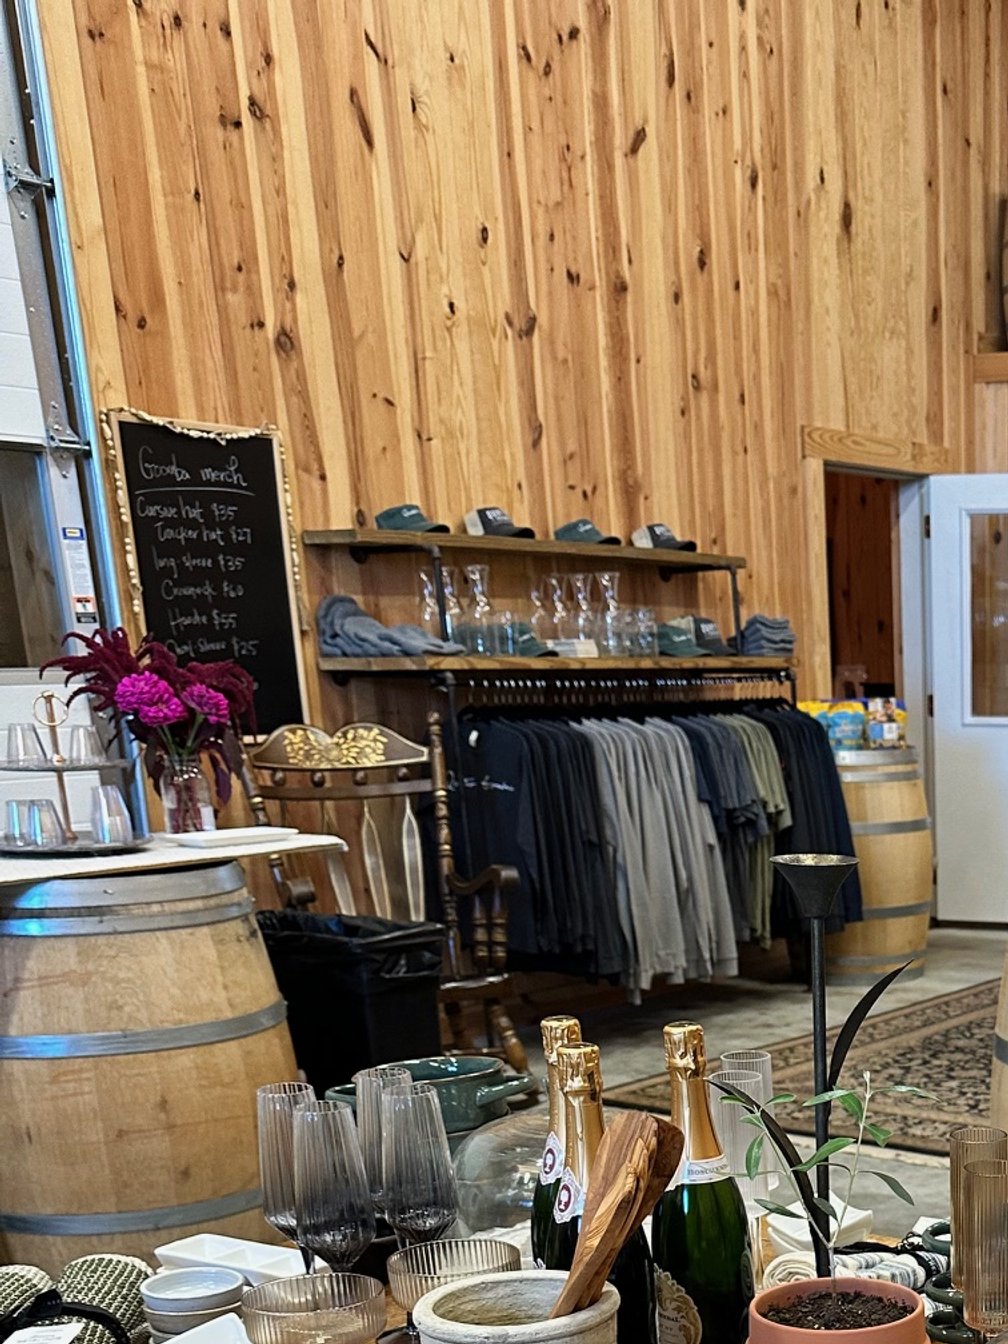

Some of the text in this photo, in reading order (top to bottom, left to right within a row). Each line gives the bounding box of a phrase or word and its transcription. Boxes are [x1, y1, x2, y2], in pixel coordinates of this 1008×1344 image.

[200, 455, 248, 487] merch
[179, 496, 204, 523] hat
[210, 502, 238, 522] $35
[202, 524, 224, 546] hat
[229, 525, 252, 545] $27
[217, 552, 245, 572] $35
[222, 579, 245, 598] $60
[212, 608, 238, 631] $55
[230, 635, 259, 658] $25
